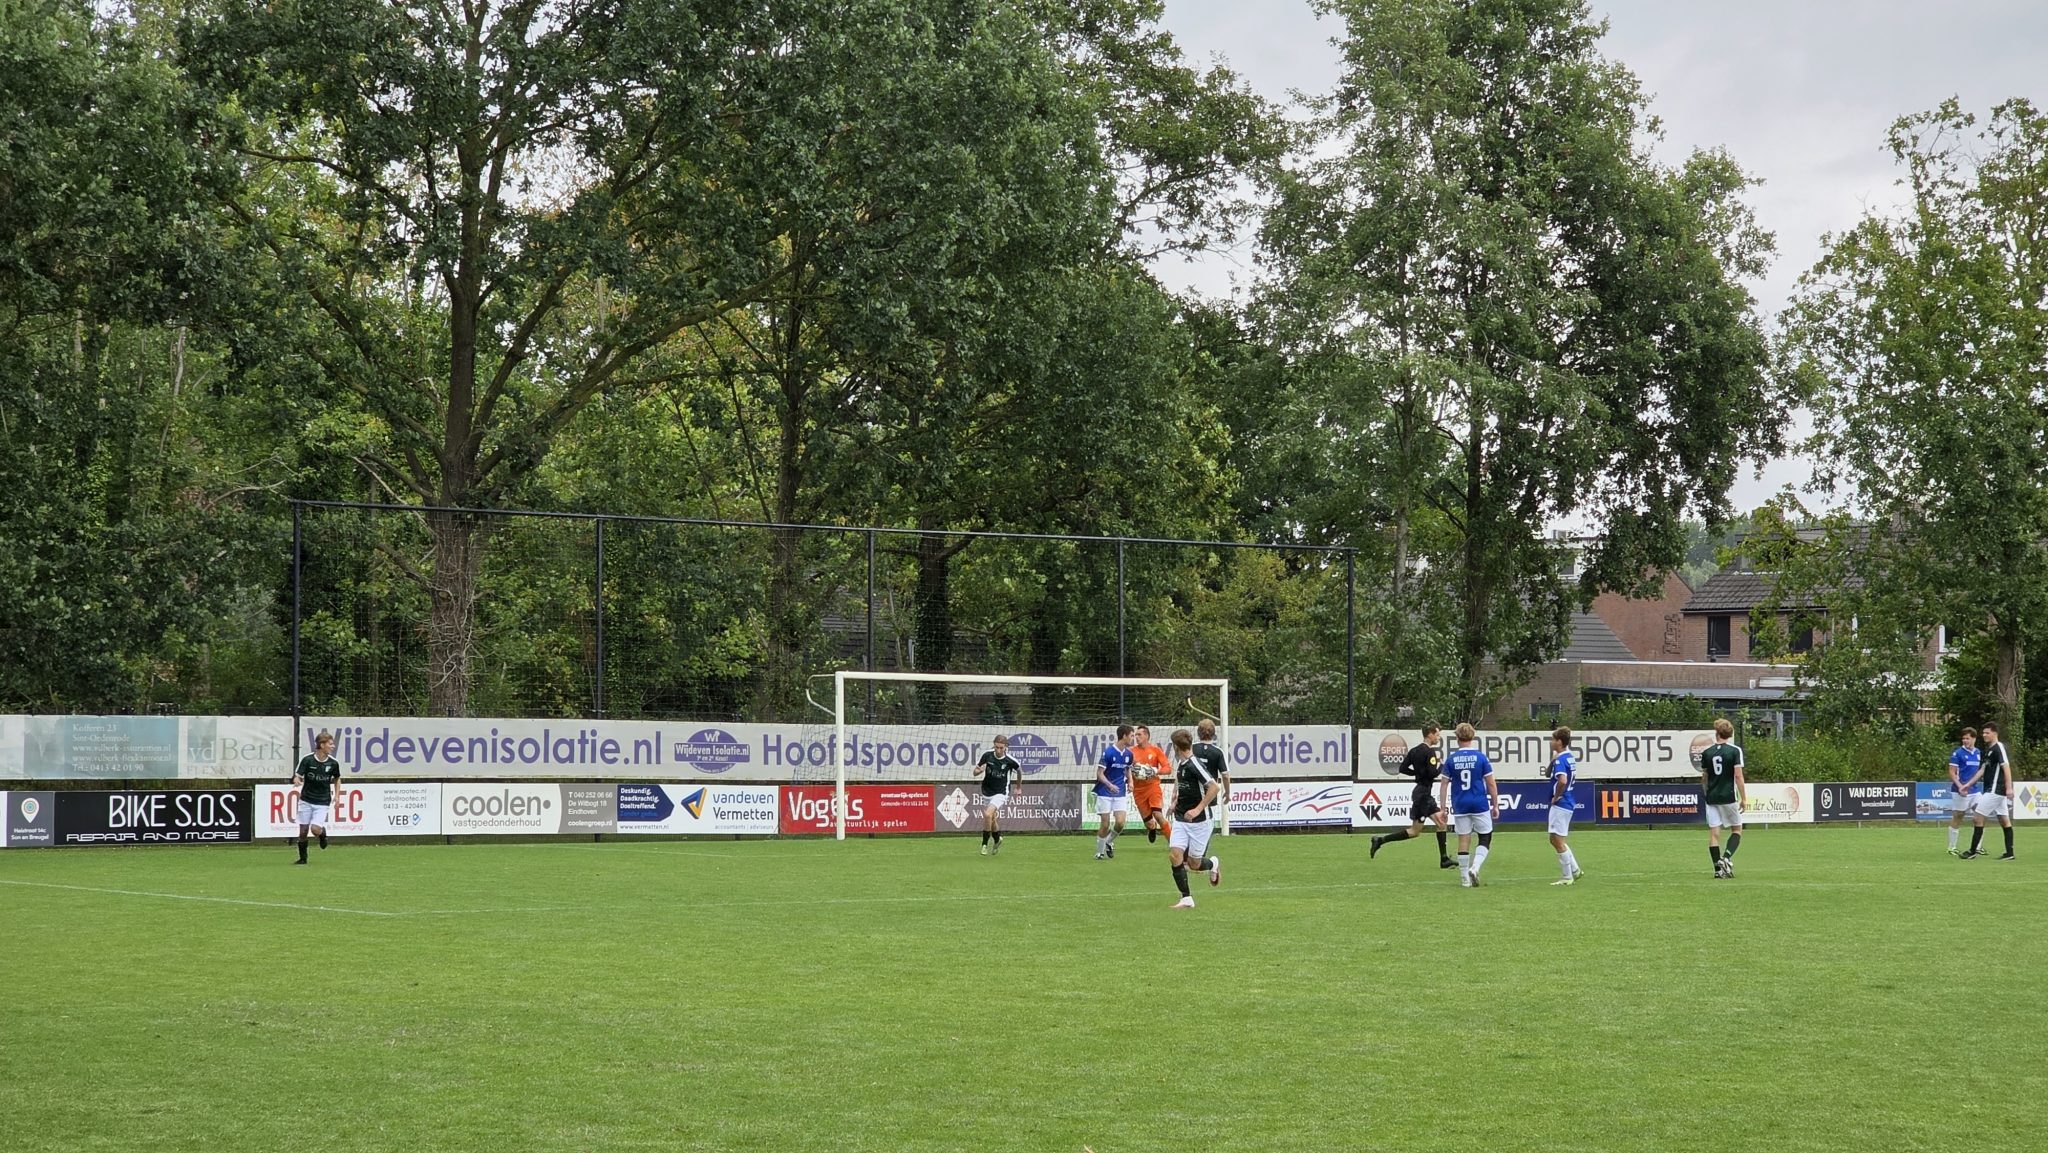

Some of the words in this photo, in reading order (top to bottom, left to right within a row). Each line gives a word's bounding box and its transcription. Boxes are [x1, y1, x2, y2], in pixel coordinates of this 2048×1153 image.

[190, 741, 214, 761] vd
[222, 736, 286, 760] Berk
[306, 727, 661, 772] Wijdevenisolatie.nl
[676, 744, 710, 757] Wijdeven
[712, 745, 750, 756] Isolatie.nl
[763, 734, 980, 774] Hoofdsponsor
[1026, 748, 1058, 758] Isolatie.nl
[1570, 736, 1672, 763] SPORTS
[90, 764, 109, 772] 0413
[111, 764, 120, 772] 42
[134, 764, 144, 772] 90
[187, 765, 286, 775] FLEXKANTOOR
[1712, 756, 1722, 776] 6
[1460, 770, 1472, 790] 9
[712, 791, 774, 804] vandeven
[1231, 788, 1282, 802] ambert
[1849, 788, 1866, 798] VAN
[1867, 788, 1883, 798] DER
[1884, 786, 1908, 797] STEEN
[452, 789, 541, 816] coolen
[1490, 794, 1522, 810] SV
[1632, 794, 1698, 805] HORECAHEREN
[1767, 798, 1786, 811] Steen
[109, 795, 166, 828] BIKE
[175, 794, 240, 827] S.O.S.
[713, 807, 774, 820] Vermetten
[1007, 807, 1080, 819] MEULENGRAAF
[1388, 808, 1406, 816] VAN
[388, 816, 409, 826] VEB
[452, 818, 542, 829] vastgoedonderhoud
[568, 820, 612, 828] coolengroep.nl
[830, 820, 878, 828] avtuurlijk
[883, 820, 908, 828] spelen
[66, 833, 139, 842] REPAIR
[143, 832, 180, 841] AND
[185, 832, 240, 840] MORE
